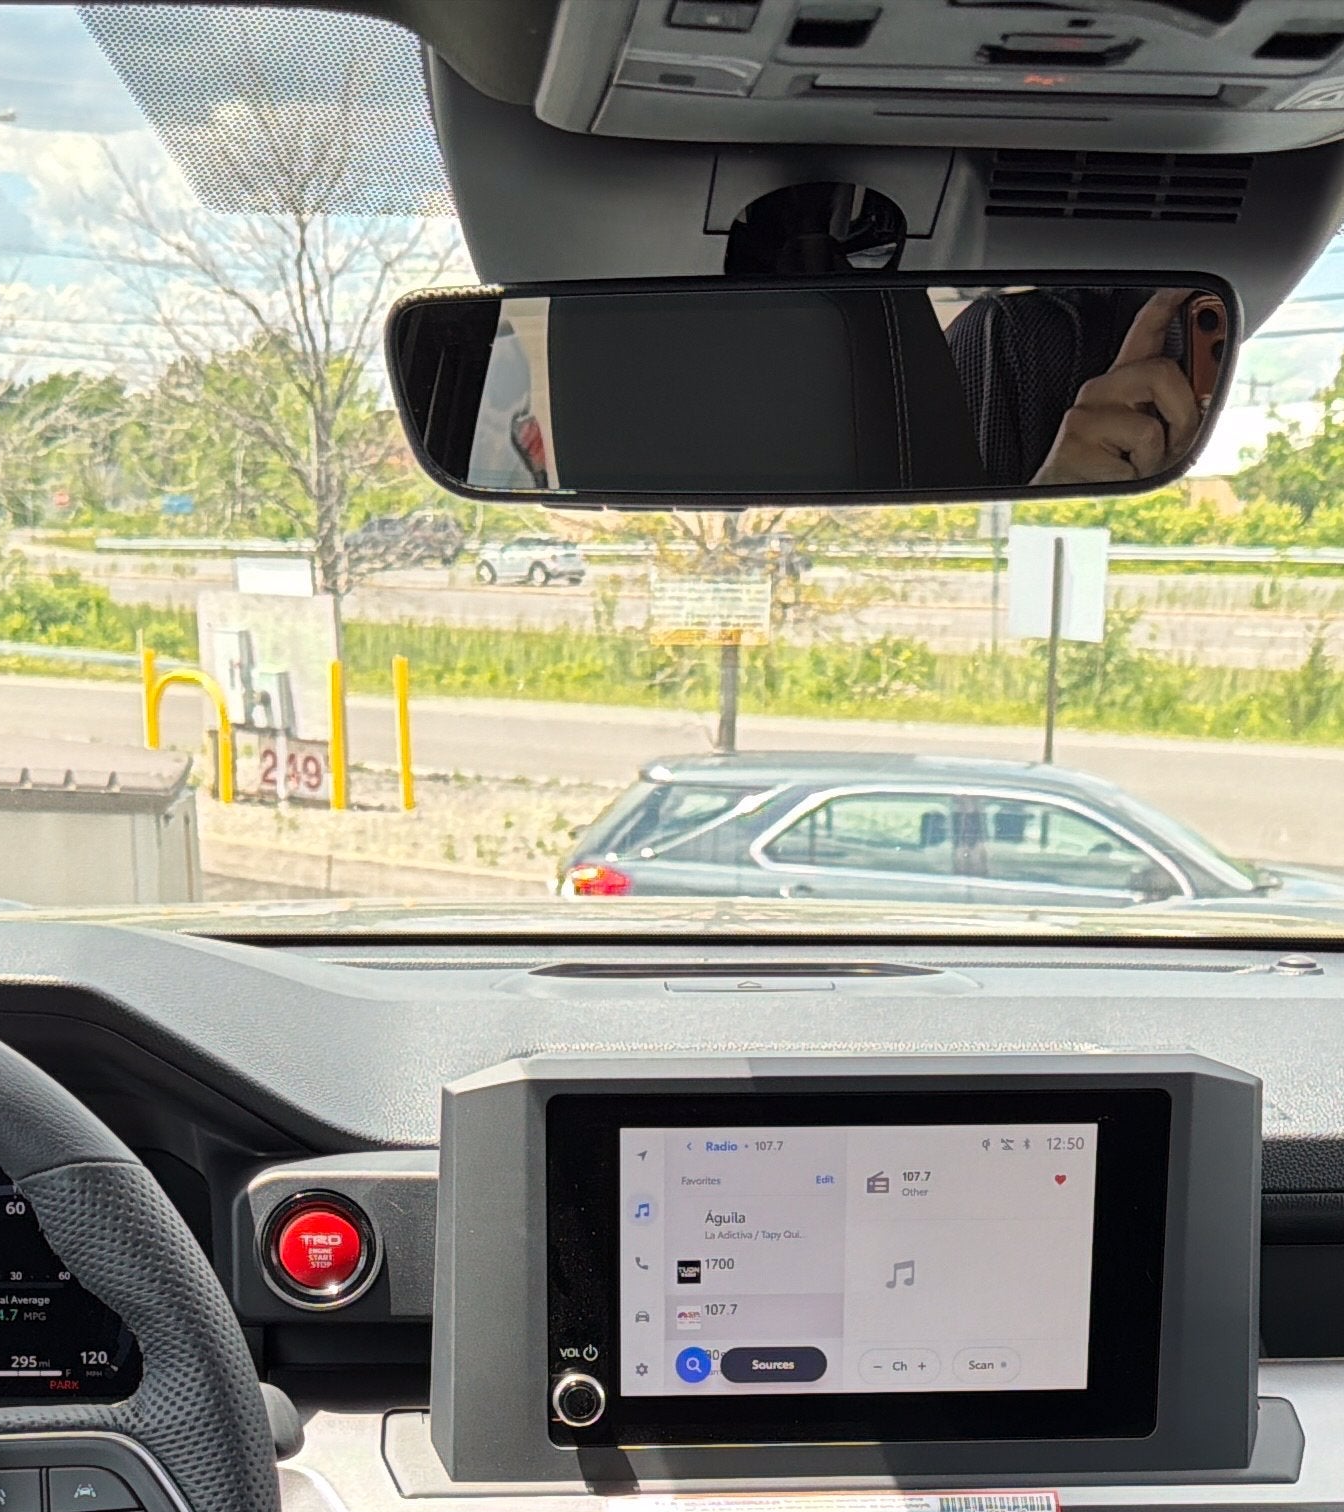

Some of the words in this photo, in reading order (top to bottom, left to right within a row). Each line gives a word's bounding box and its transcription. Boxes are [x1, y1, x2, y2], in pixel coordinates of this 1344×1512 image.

[706, 1141, 738, 1151] Radio
[755, 1140, 784, 1151] 107.7
[1046, 1136, 1085, 1150] 12:50
[681, 1176, 721, 1185] Favorites
[816, 1174, 834, 1185] Edit
[902, 1171, 931, 1182] 107.7
[902, 1187, 929, 1197] Other
[5, 1201, 26, 1216] 60
[705, 1209, 746, 1227] Águila
[299, 1234, 343, 1247] TRD
[705, 1258, 735, 1270] 1700
[10, 1271, 22, 1282] 30
[58, 1271, 71, 1282] 60
[10, 1295, 51, 1307] Average
[705, 1303, 738, 1316] 107.7
[23, 1311, 47, 1322] MPG
[79, 1350, 107, 1366] 120
[559, 1347, 581, 1358] VOL
[10, 1355, 37, 1369] 295
[751, 1359, 795, 1371] Sources
[892, 1361, 908, 1372] Ch
[968, 1359, 994, 1370] Scan
[49, 1380, 80, 1391] PARK
